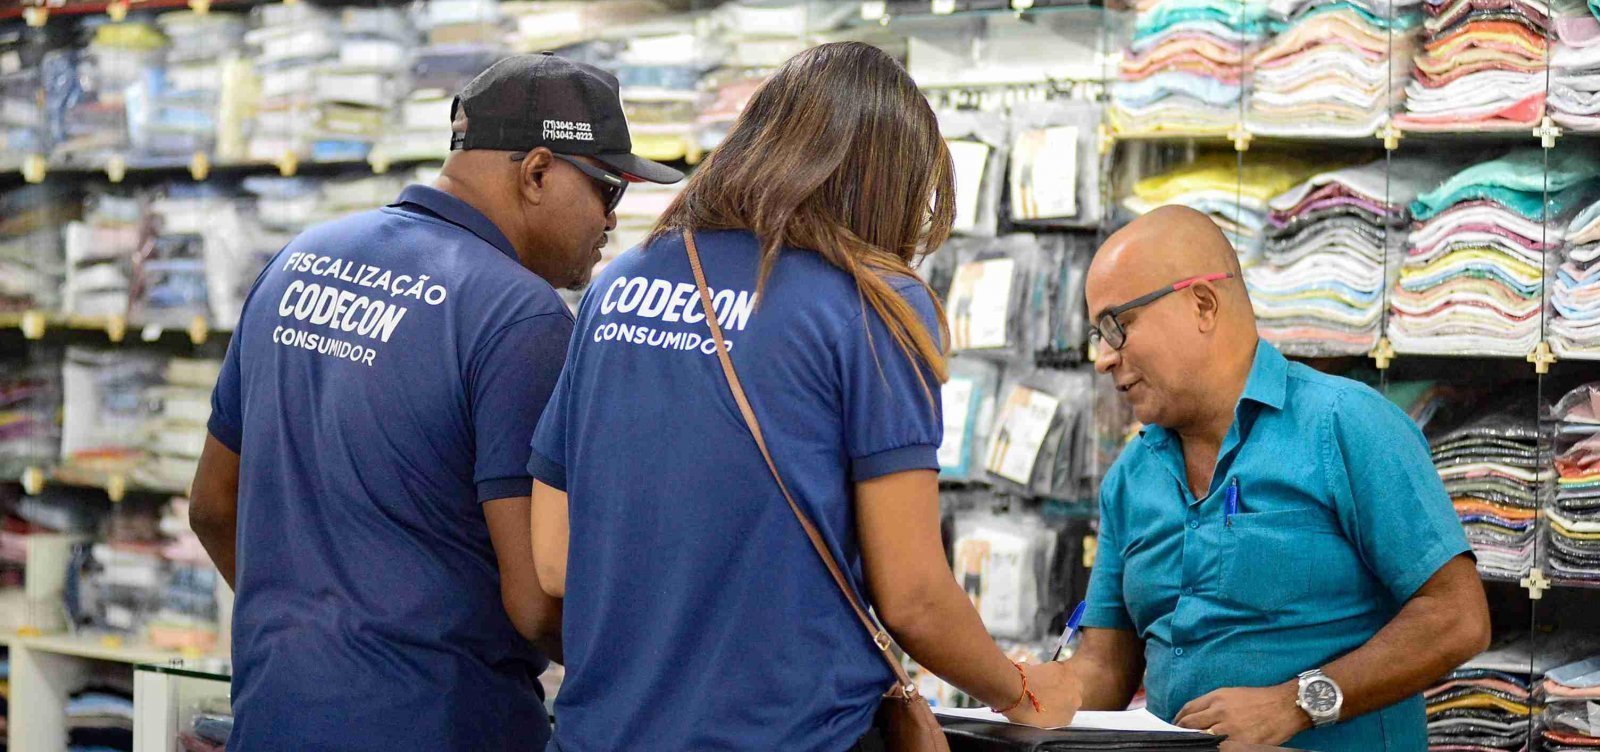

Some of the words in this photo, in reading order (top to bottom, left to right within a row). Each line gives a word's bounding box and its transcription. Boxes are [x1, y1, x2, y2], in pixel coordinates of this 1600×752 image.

[283, 252, 447, 306] FISCALIZAÇÃO
[600, 276, 759, 331] CODECON
[278, 279, 408, 343] CODECON
[272, 325, 377, 366] CONSUMIDOR
